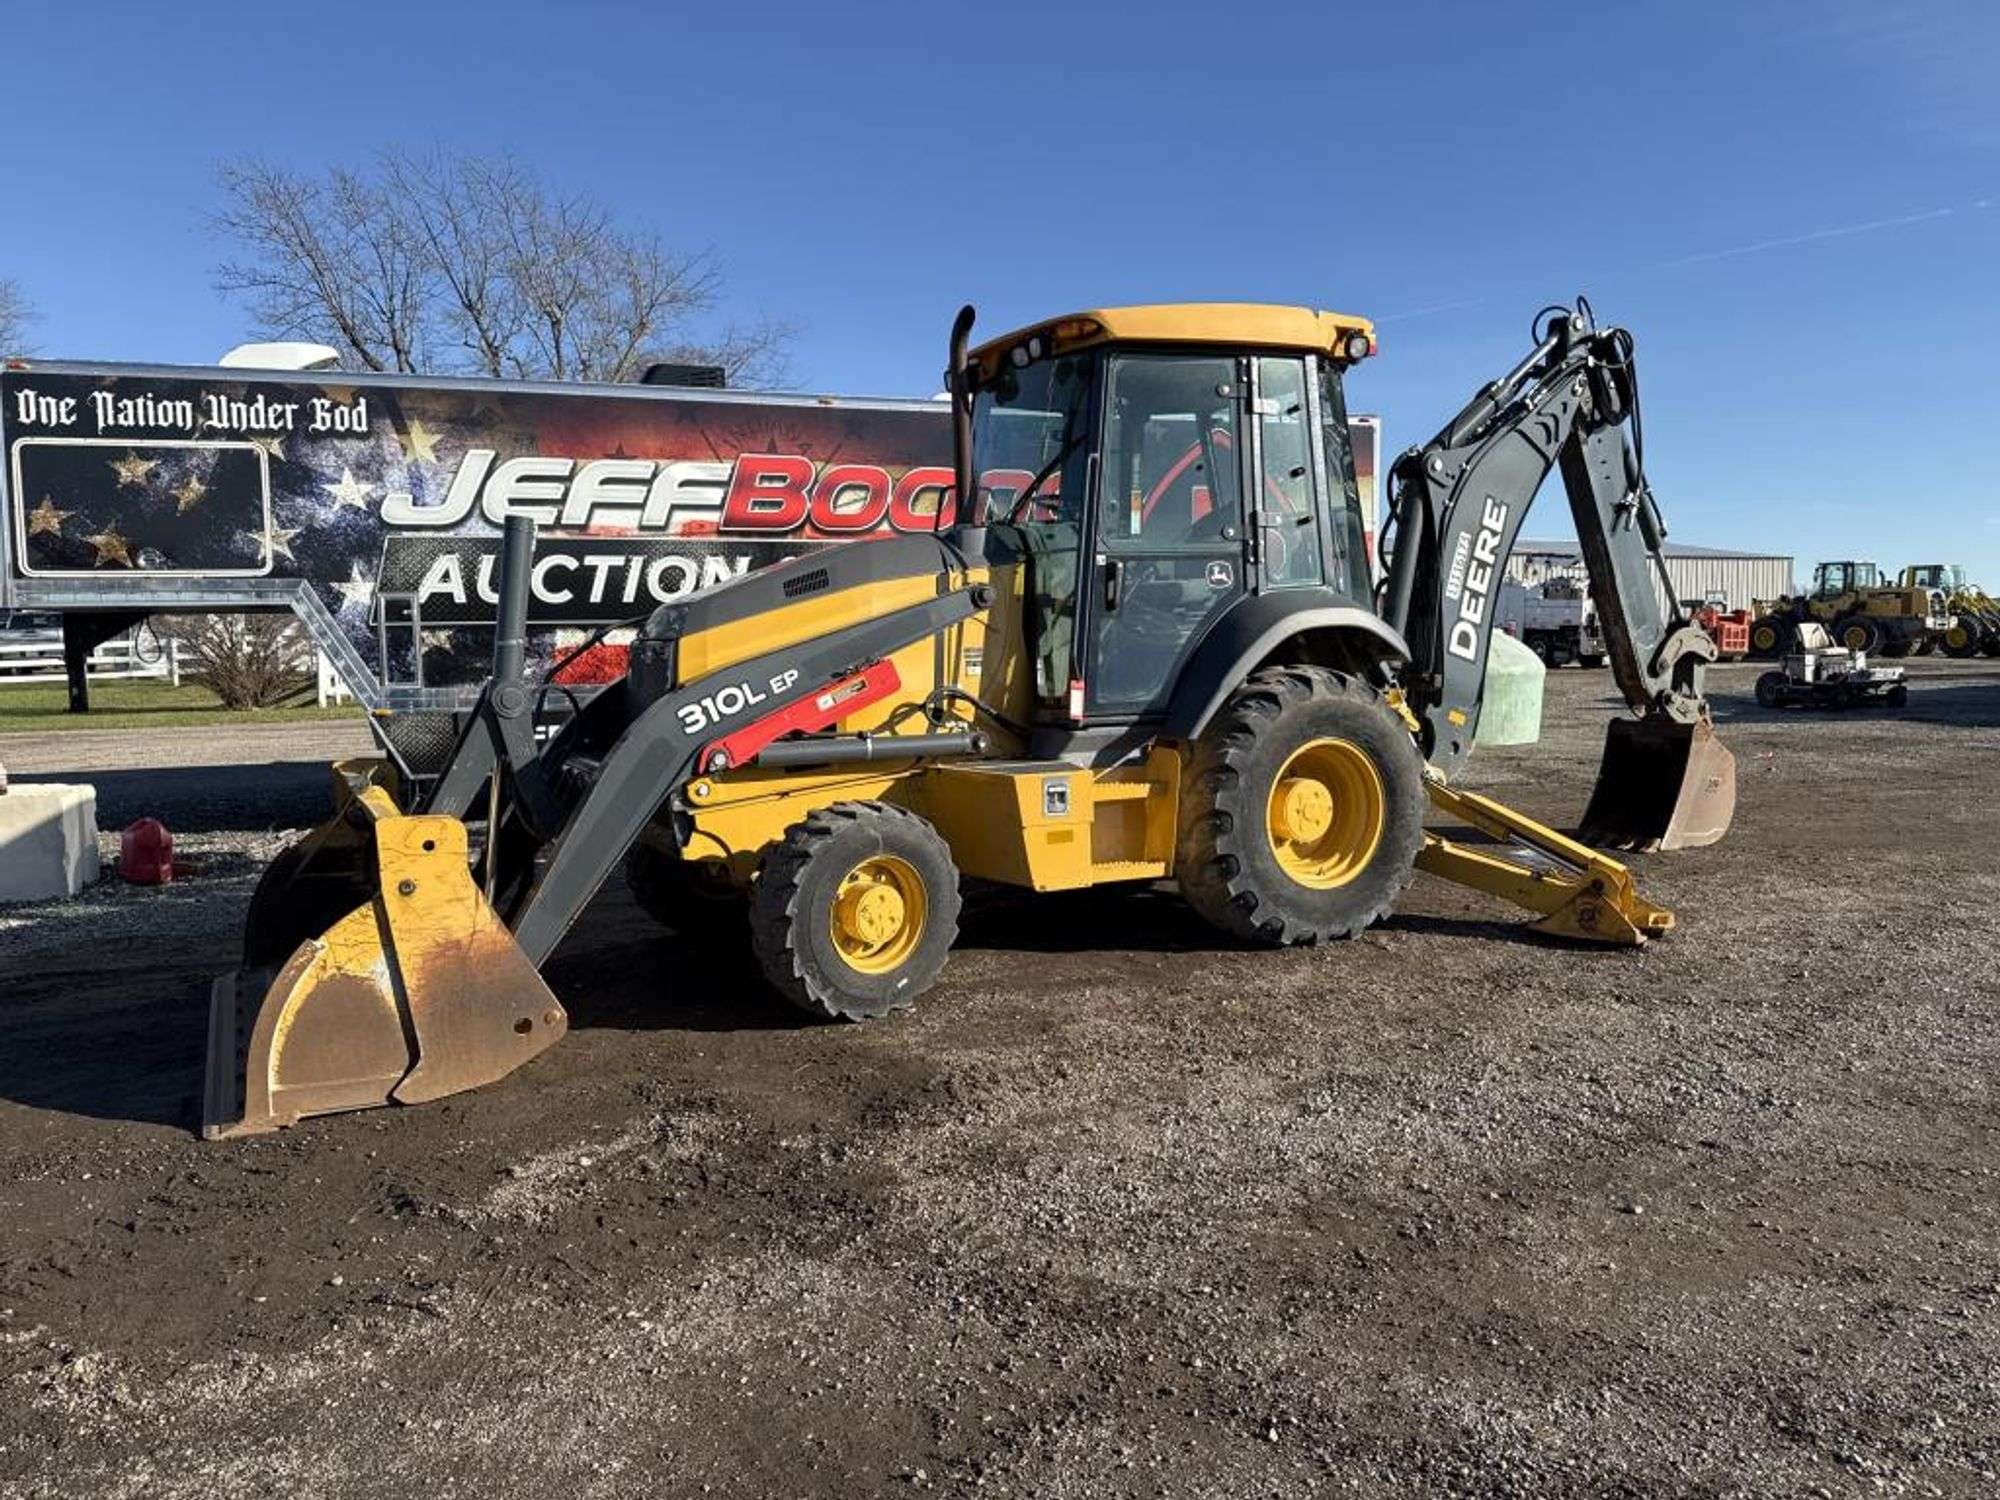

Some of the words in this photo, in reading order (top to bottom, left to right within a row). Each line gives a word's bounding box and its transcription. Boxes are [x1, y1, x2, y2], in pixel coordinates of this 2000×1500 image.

[14, 388, 78, 427] One
[86, 390, 194, 435] Nation
[203, 393, 299, 434] Under
[309, 397, 369, 433] God
[1449, 496, 1508, 665] DEERE
[677, 683, 767, 735] 310L
[769, 669, 799, 695] EP
